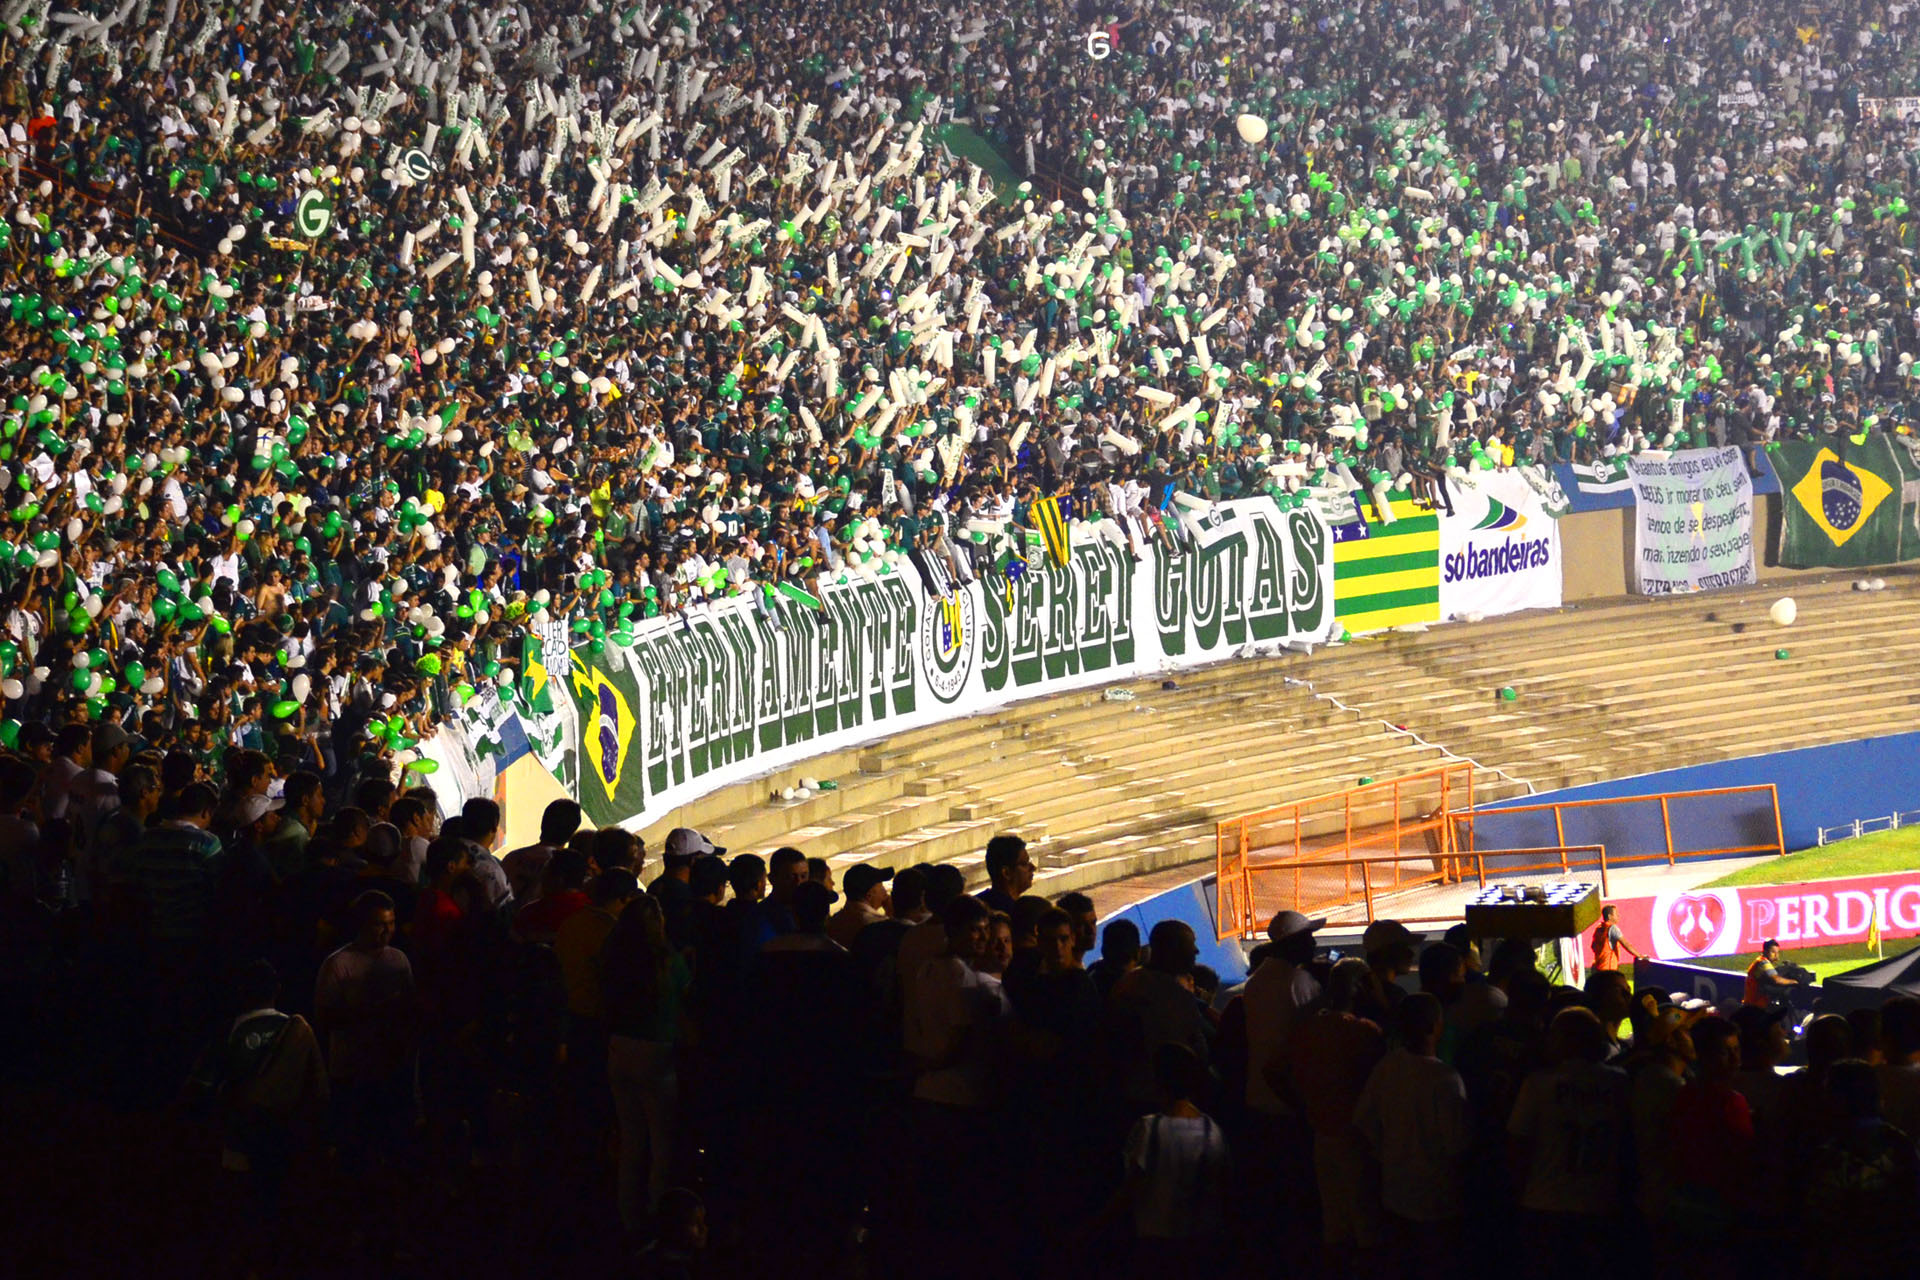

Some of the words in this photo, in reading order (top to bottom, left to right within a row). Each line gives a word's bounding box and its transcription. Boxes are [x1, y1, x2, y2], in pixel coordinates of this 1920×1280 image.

[405, 149, 431, 181] G
[299, 189, 330, 237] G
[1594, 463, 1607, 481] G
[1209, 508, 1221, 527] G
[1674, 516, 1686, 534] de
[1466, 533, 1550, 580] bandeiras
[632, 572, 917, 797] ETERNAMENTE
[980, 537, 1136, 692] SEREI
